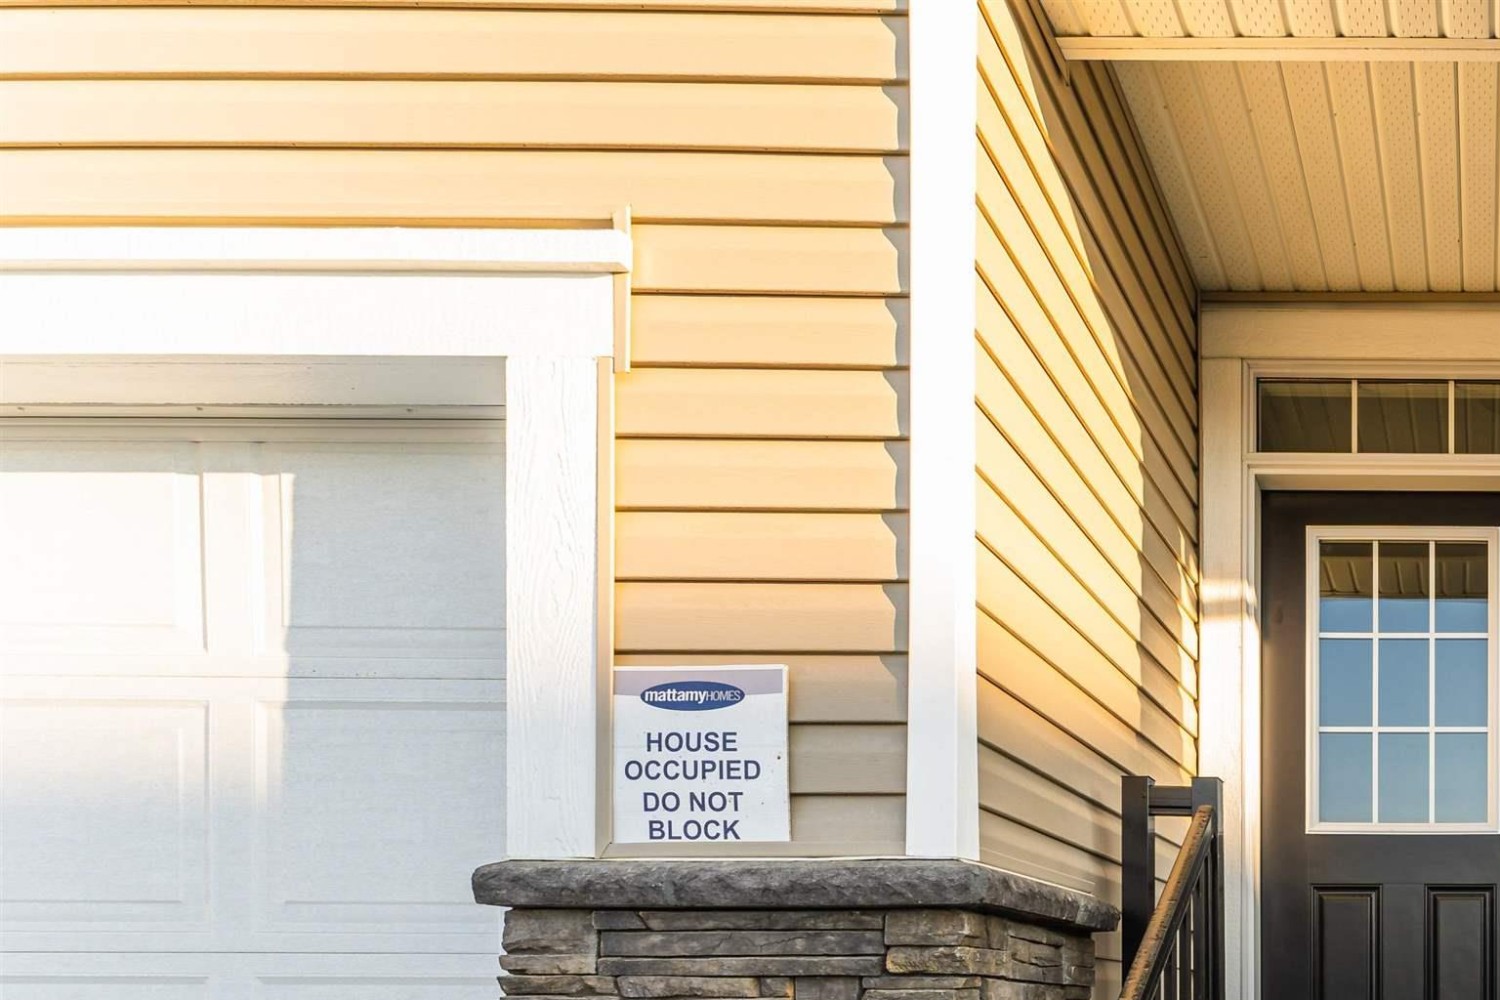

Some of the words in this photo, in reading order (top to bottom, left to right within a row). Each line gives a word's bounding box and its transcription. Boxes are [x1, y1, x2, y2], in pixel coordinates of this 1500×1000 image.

[644, 688, 742, 704] mattamyHOMES
[646, 732, 738, 752] HOUSE
[624, 760, 761, 780] OCCUPIED
[643, 792, 680, 812] DO
[690, 792, 743, 812] NOT
[648, 820, 741, 840] BLOCK
